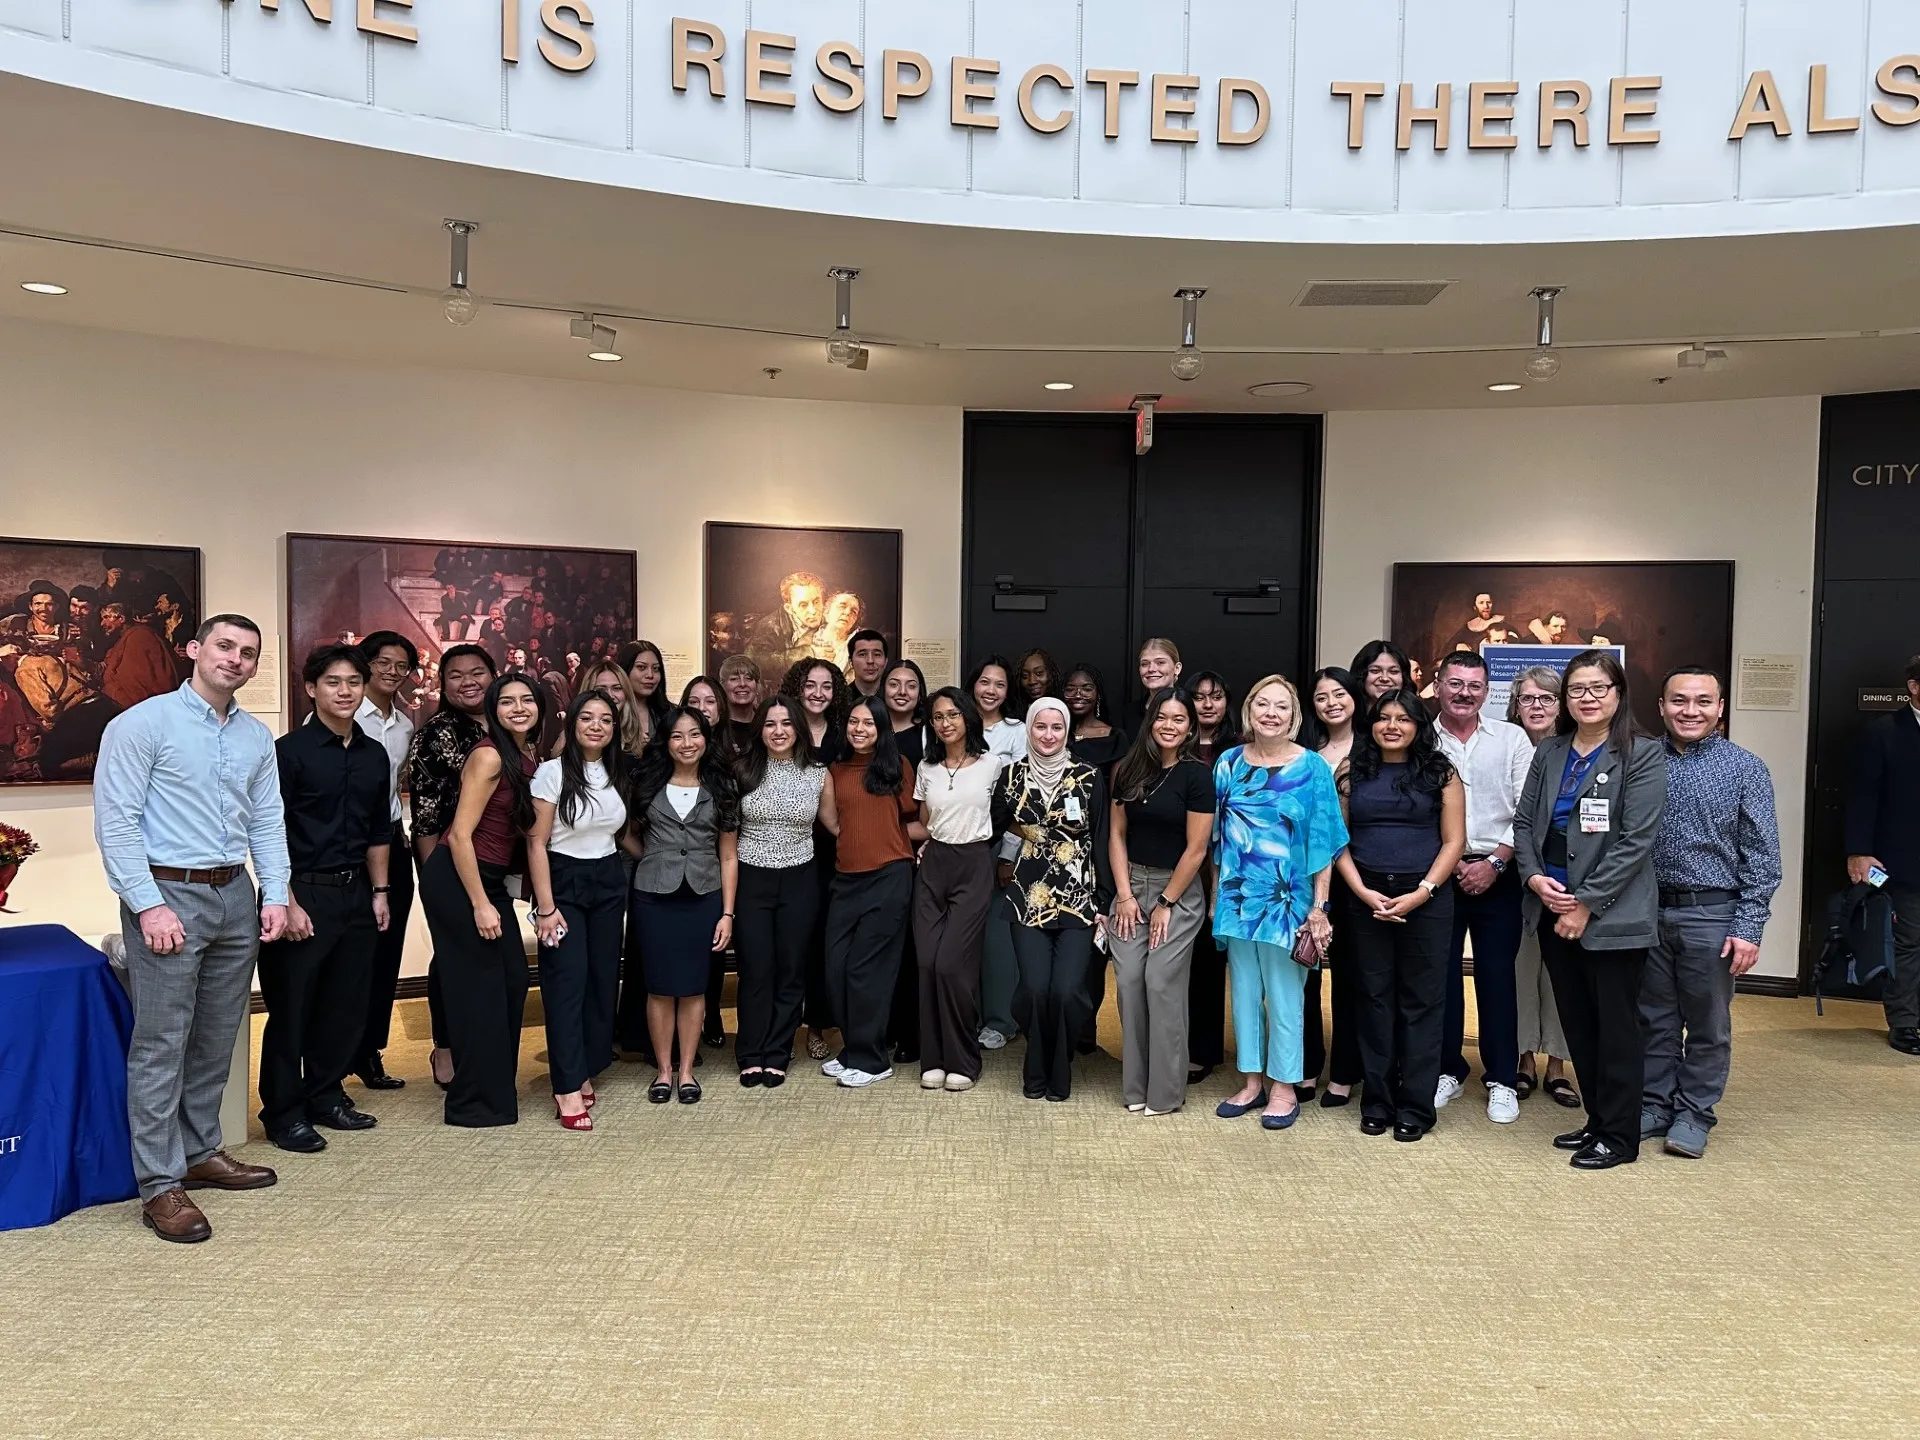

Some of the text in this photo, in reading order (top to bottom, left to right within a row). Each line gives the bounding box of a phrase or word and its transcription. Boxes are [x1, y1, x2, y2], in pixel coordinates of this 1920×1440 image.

[501, 0, 597, 72] IS
[671, 17, 1272, 146] RESPECTED
[1330, 76, 1663, 150] THERE
[1727, 54, 1920, 141] ALS
[1852, 463, 1920, 486] CITY
